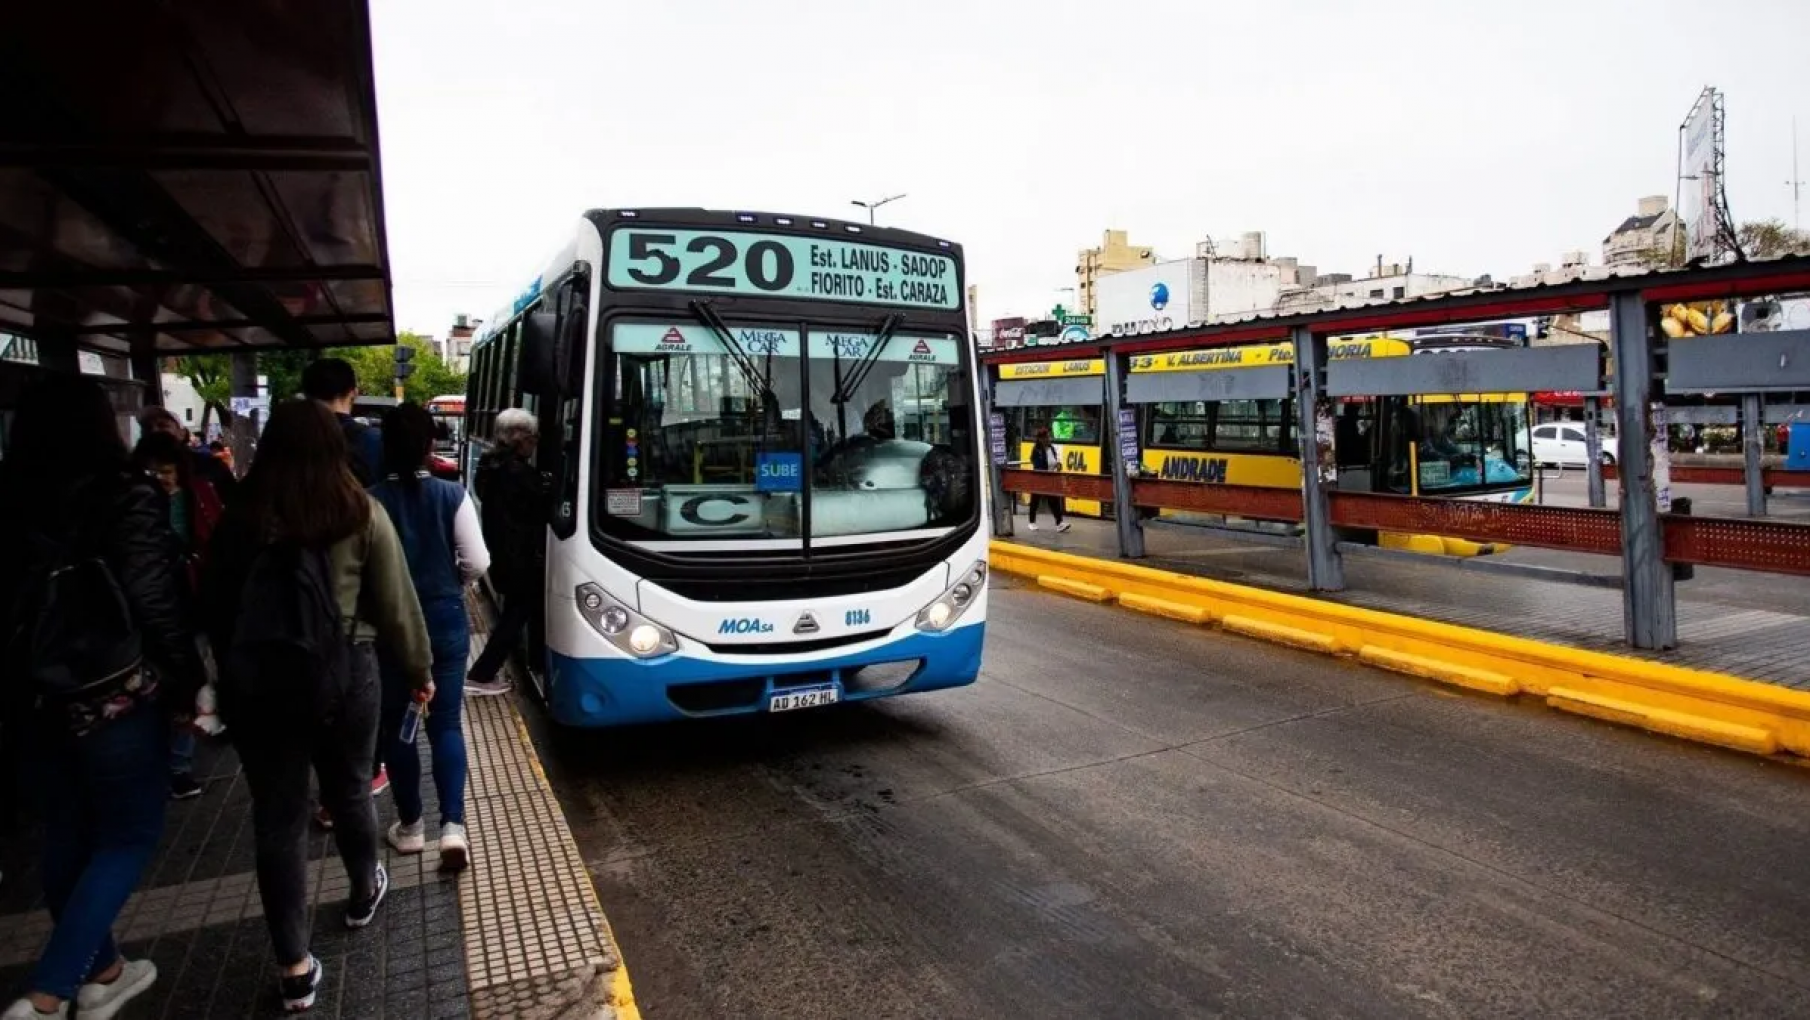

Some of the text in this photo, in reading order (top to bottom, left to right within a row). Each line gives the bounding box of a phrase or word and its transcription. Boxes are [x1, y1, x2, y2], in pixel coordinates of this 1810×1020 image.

[627, 233, 795, 291] 520
[810, 244, 837, 269] Est.
[841, 247, 889, 273] LANUS
[901, 253, 947, 279] SADOP
[811, 271, 864, 297] FIORITO
[876, 278, 898, 300] Est.
[900, 280, 948, 305] CARAZA
[739, 329, 788, 344] MEGA
[655, 343, 692, 352] AGRALE
[908, 354, 936, 362] AGRALE
[1178, 350, 1242, 366] ALBERTINA
[760, 463, 798, 478] SUBE
[1161, 455, 1228, 483] ANDRADE
[845, 608, 870, 626] 8136
[793, 694, 816, 707] 162
